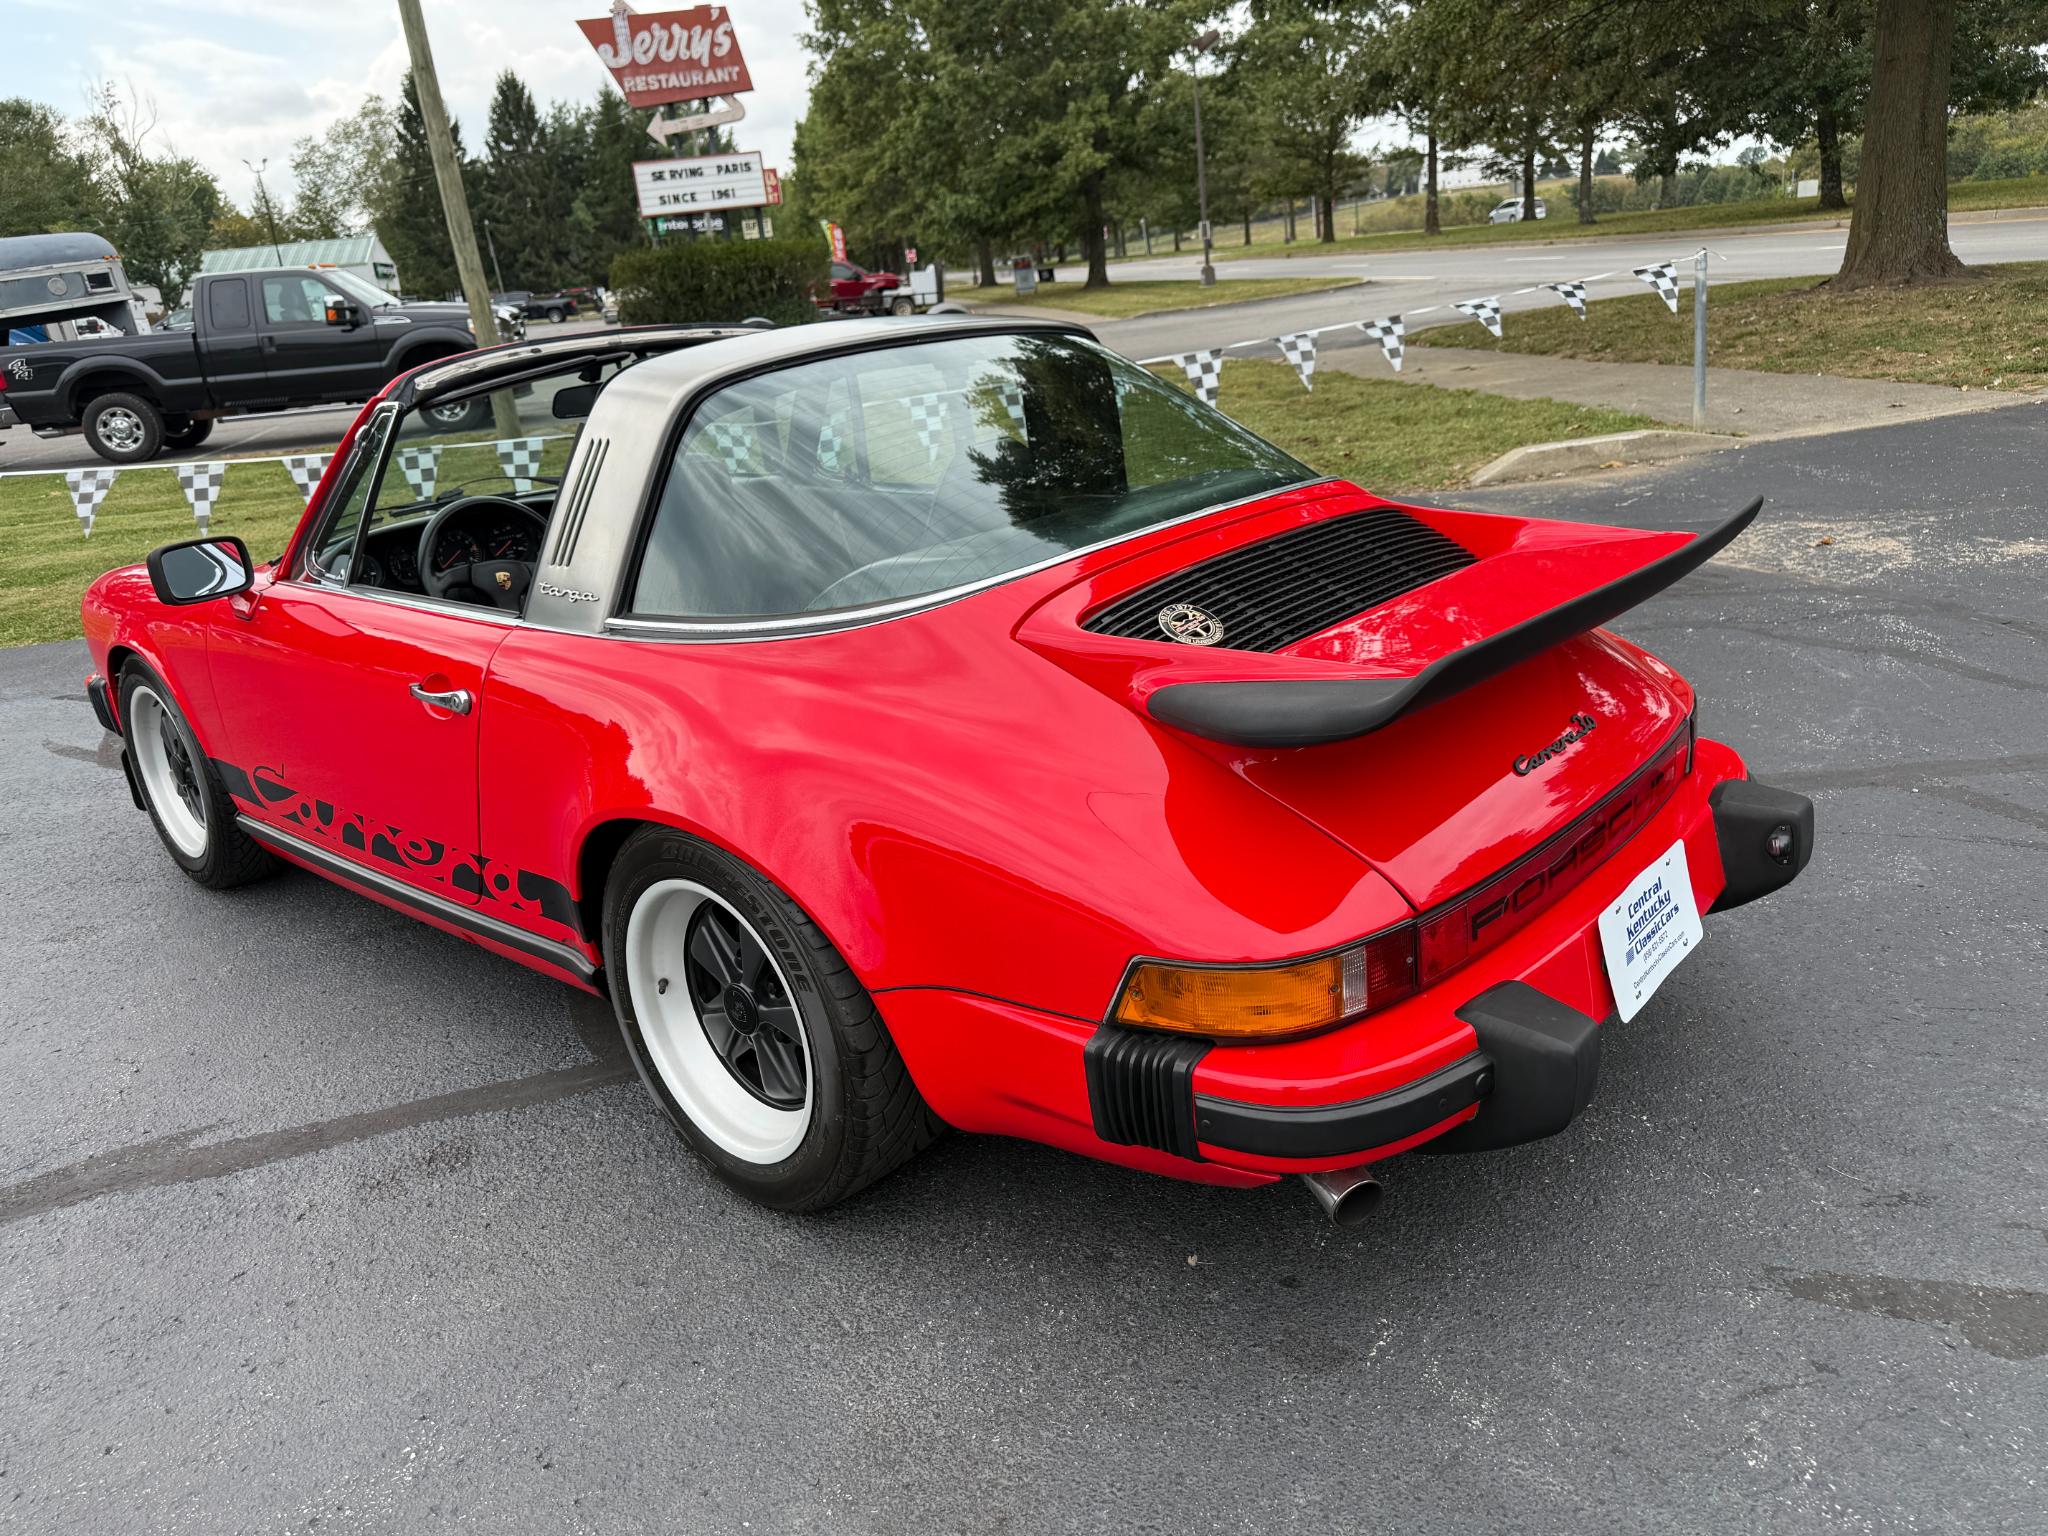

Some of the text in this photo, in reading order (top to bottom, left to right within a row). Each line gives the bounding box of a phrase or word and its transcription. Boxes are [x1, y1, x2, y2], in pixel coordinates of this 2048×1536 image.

[597, 8, 732, 69] Jerry's
[623, 65, 740, 92] RESTAURANT
[717, 162, 752, 175] PARIS
[659, 188, 736, 206] SINCE 1961
[538, 581, 600, 603] targa
[1513, 730, 1586, 777] Carrera
[247, 762, 543, 916] Carrera
[1626, 889, 1672, 941] Kentucky
[1628, 876, 1663, 920] Central
[1635, 903, 1680, 955] ClassicCars
